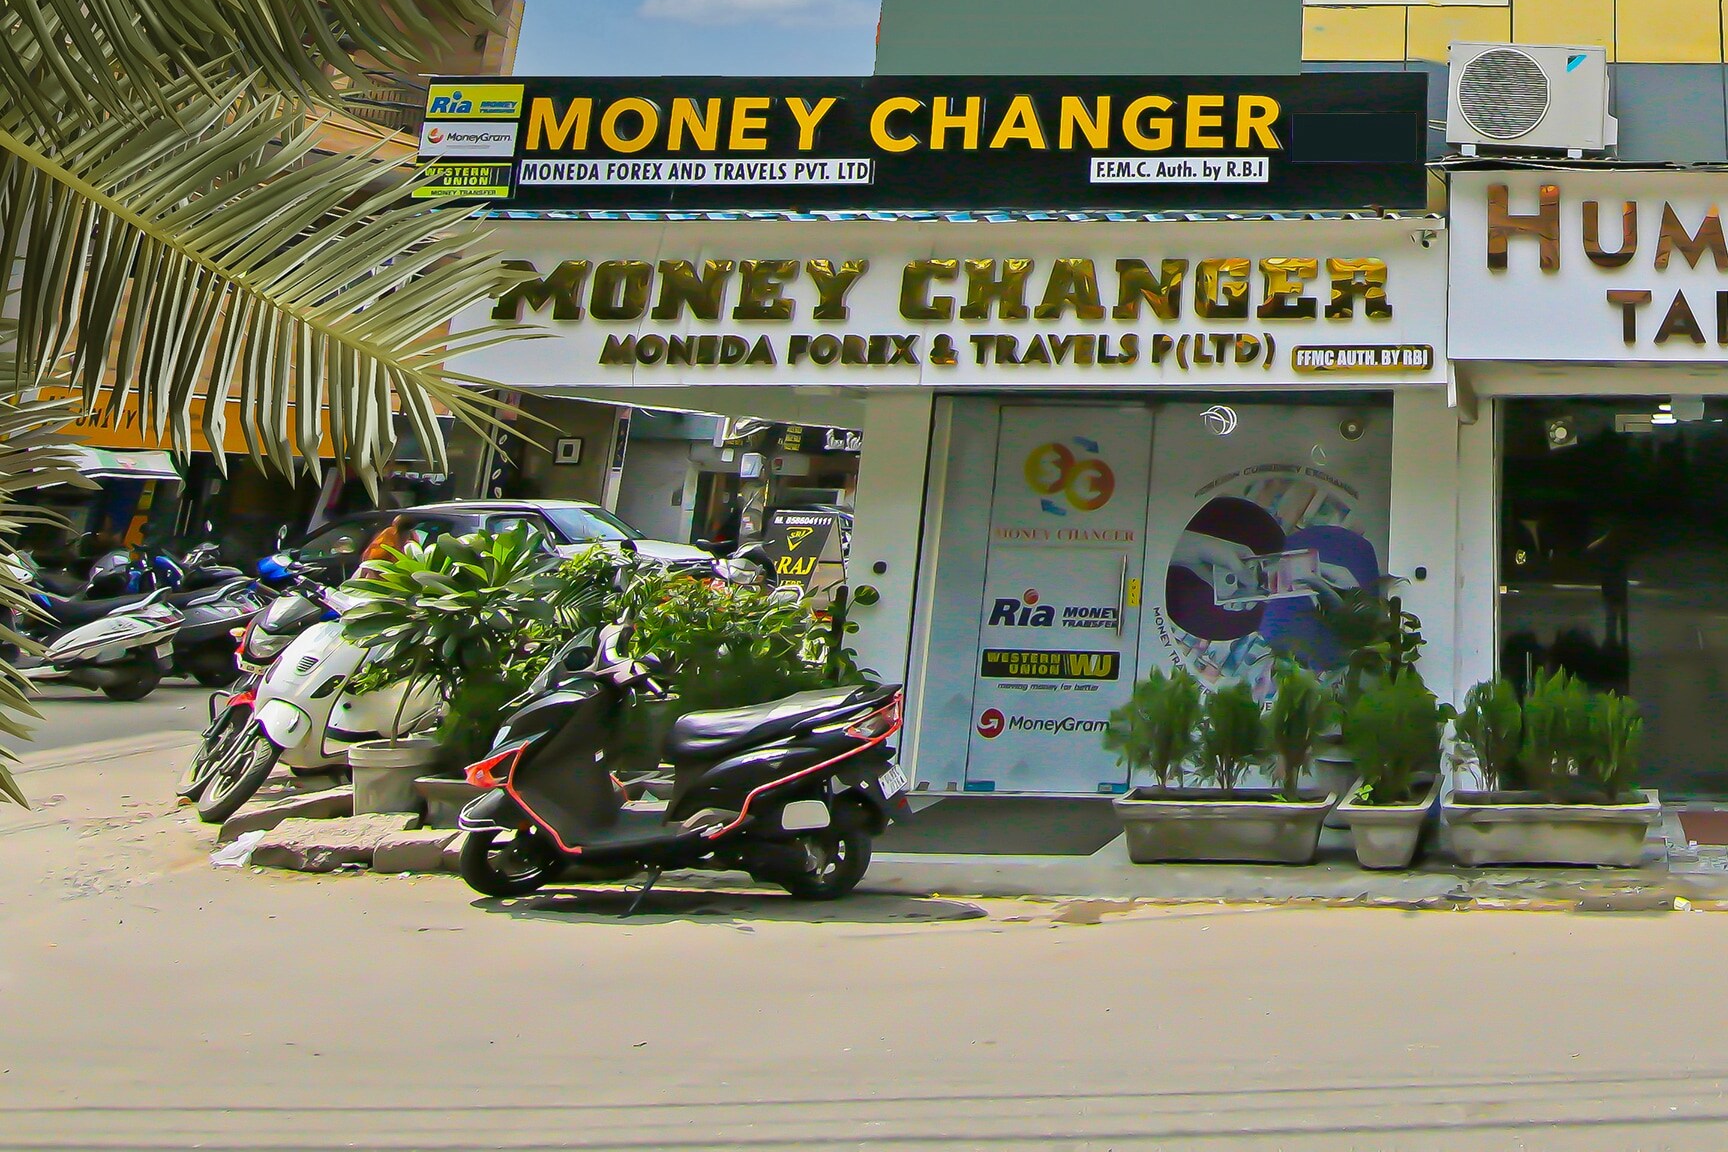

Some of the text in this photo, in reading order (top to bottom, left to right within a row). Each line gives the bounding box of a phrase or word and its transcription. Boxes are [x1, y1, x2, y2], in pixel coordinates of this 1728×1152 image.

[429, 91, 472, 114] Ria
[525, 96, 1284, 152] MONEY CHANGER
[425, 167, 490, 177] WESTERN
[443, 177, 488, 185] UNION
[522, 161, 868, 183] MONEDA FOREX AND TRAVELS PVT. LTD
[1096, 161, 1264, 182] F.F.M.C. Auth. by R.B.I
[491, 257, 1394, 321] MONEY CHANGER
[599, 332, 1277, 370] MONEDA FOREX & TRAVELS P(LTD)
[1297, 350, 1429, 367] FFMC AUTH. BY RBI
[777, 556, 817, 575] RAJ
[988, 588, 1056, 628] Ria
[1062, 606, 1118, 619] MONEY
[1153, 606, 1172, 648] MONEY
[987, 652, 1061, 664] WESTERN
[1009, 664, 1060, 675] UNION
[1008, 715, 1110, 735] MoneyGram
